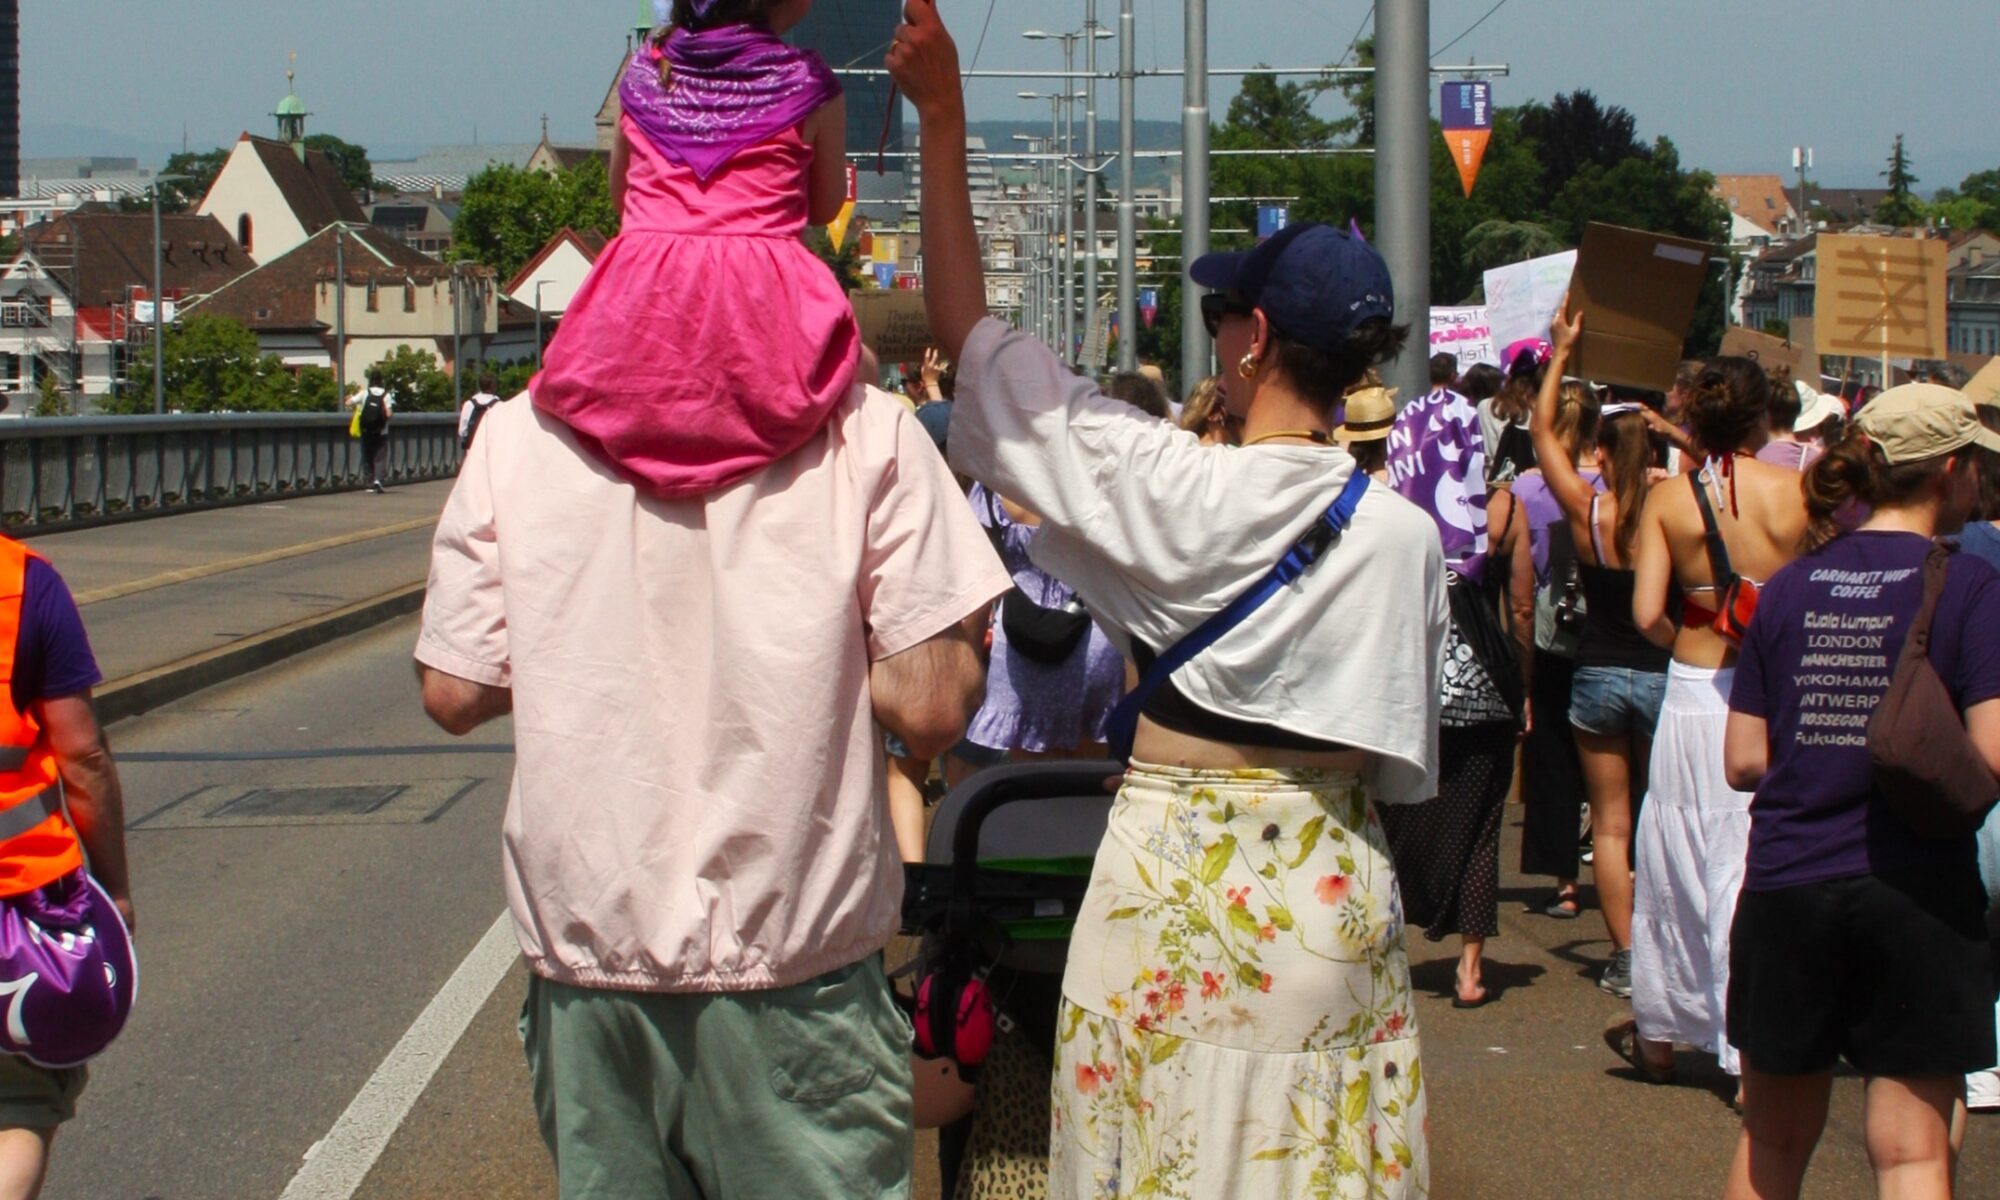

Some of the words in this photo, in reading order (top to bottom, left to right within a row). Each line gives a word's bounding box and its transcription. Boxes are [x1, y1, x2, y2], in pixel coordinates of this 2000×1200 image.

[1474, 84, 1485, 98] Art
[1474, 101, 1486, 125] Basel
[1809, 568, 1882, 585] CARHARTT
[1830, 585, 1882, 599] COFFEE
[1840, 613, 1894, 631] Lumpur
[1807, 635, 1884, 649] LONDON
[1801, 653, 1887, 668] MANCHESTER
[1793, 674, 1890, 688] YOKOHAMA
[1795, 731, 1867, 747] Fukuoka
